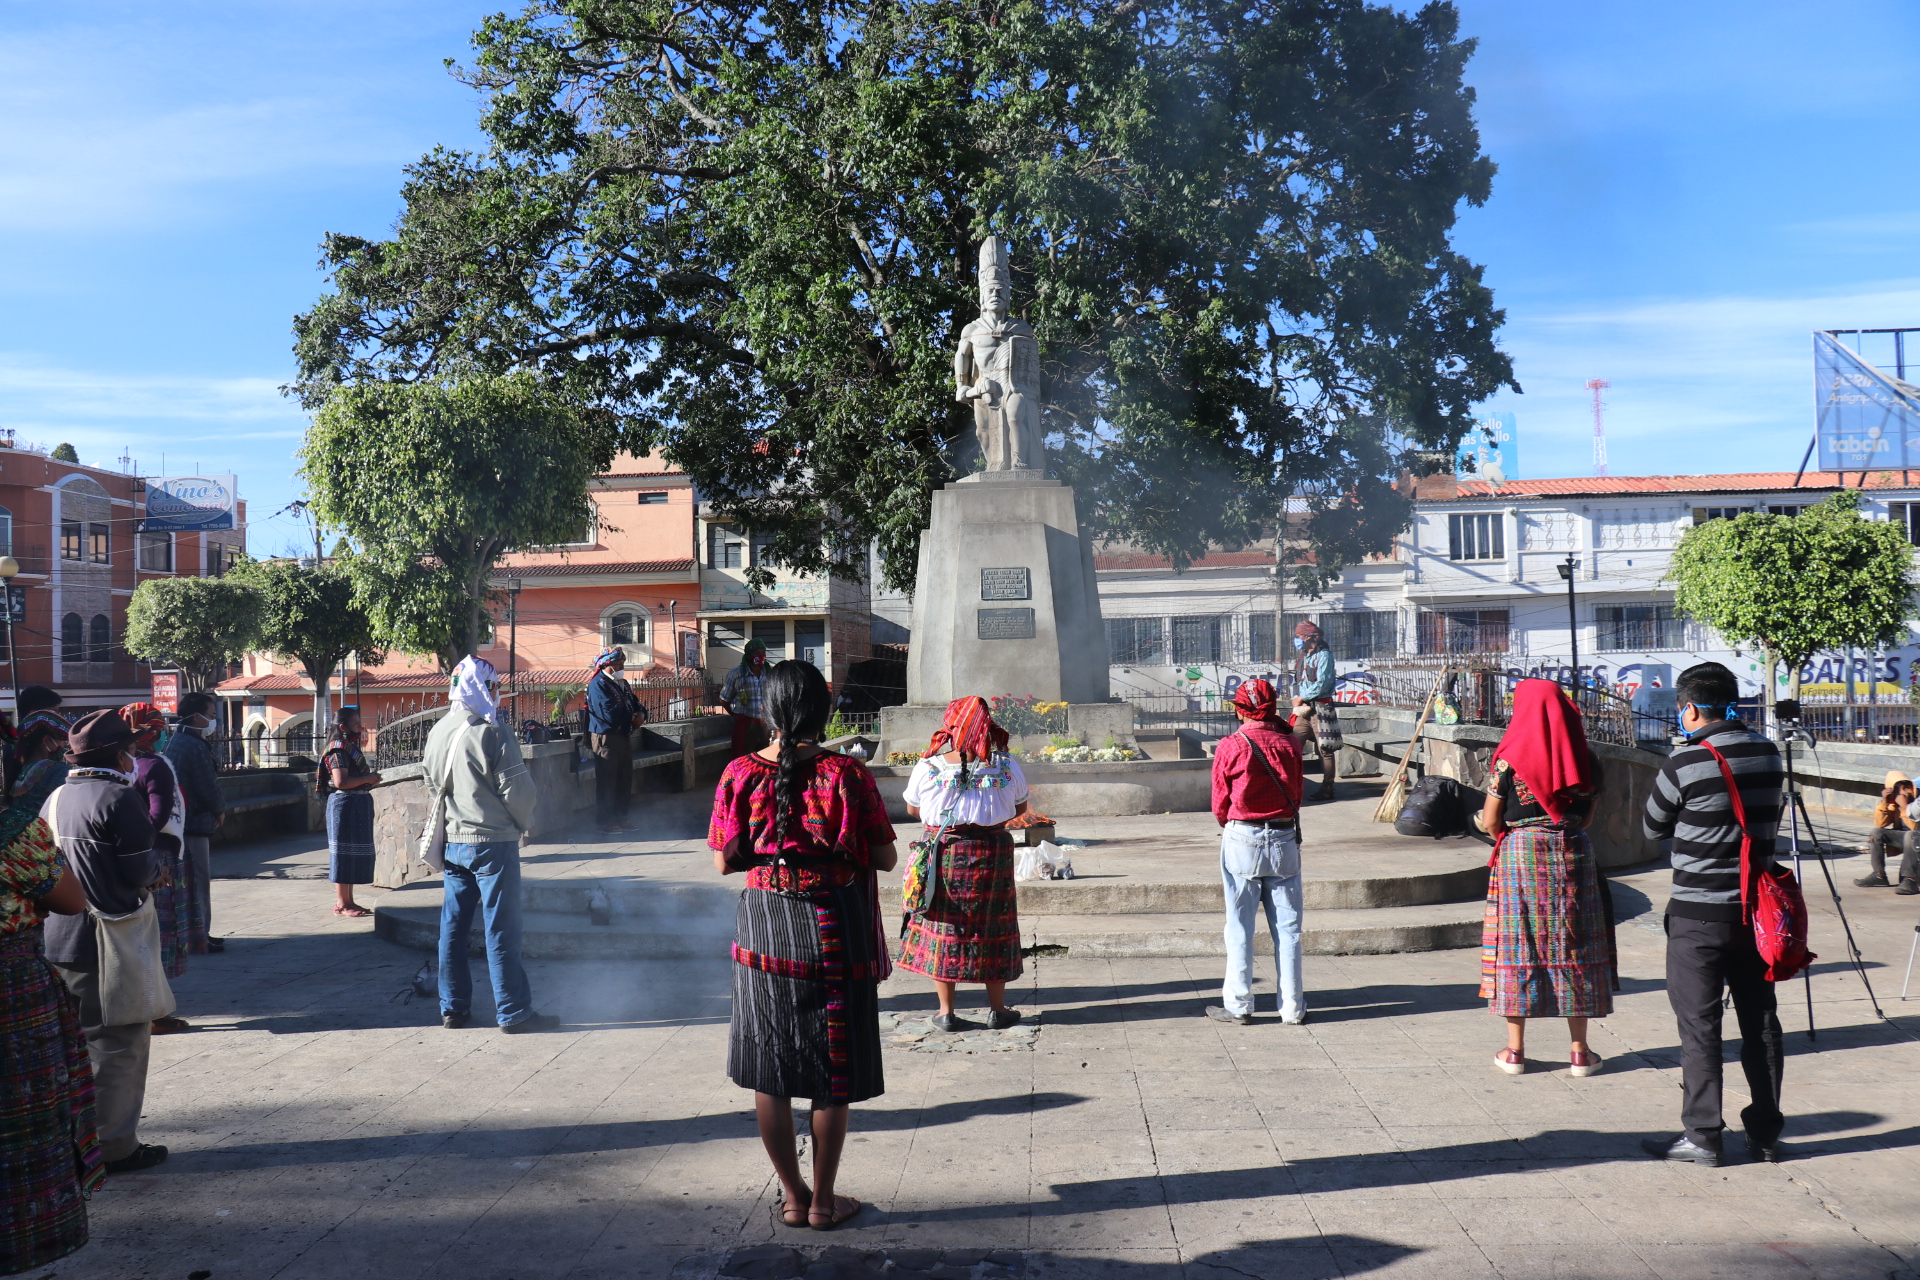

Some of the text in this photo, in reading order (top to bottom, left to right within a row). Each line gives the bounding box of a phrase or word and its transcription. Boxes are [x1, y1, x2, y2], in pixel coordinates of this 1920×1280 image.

[1827, 393, 1879, 404] Antigripl
[1828, 427, 1890, 453] tabcin
[151, 479, 225, 500] Nino's
[151, 499, 227, 513] Comercial
[1227, 665, 1269, 673] Farmacias
[1800, 656, 1901, 684] BATRES
